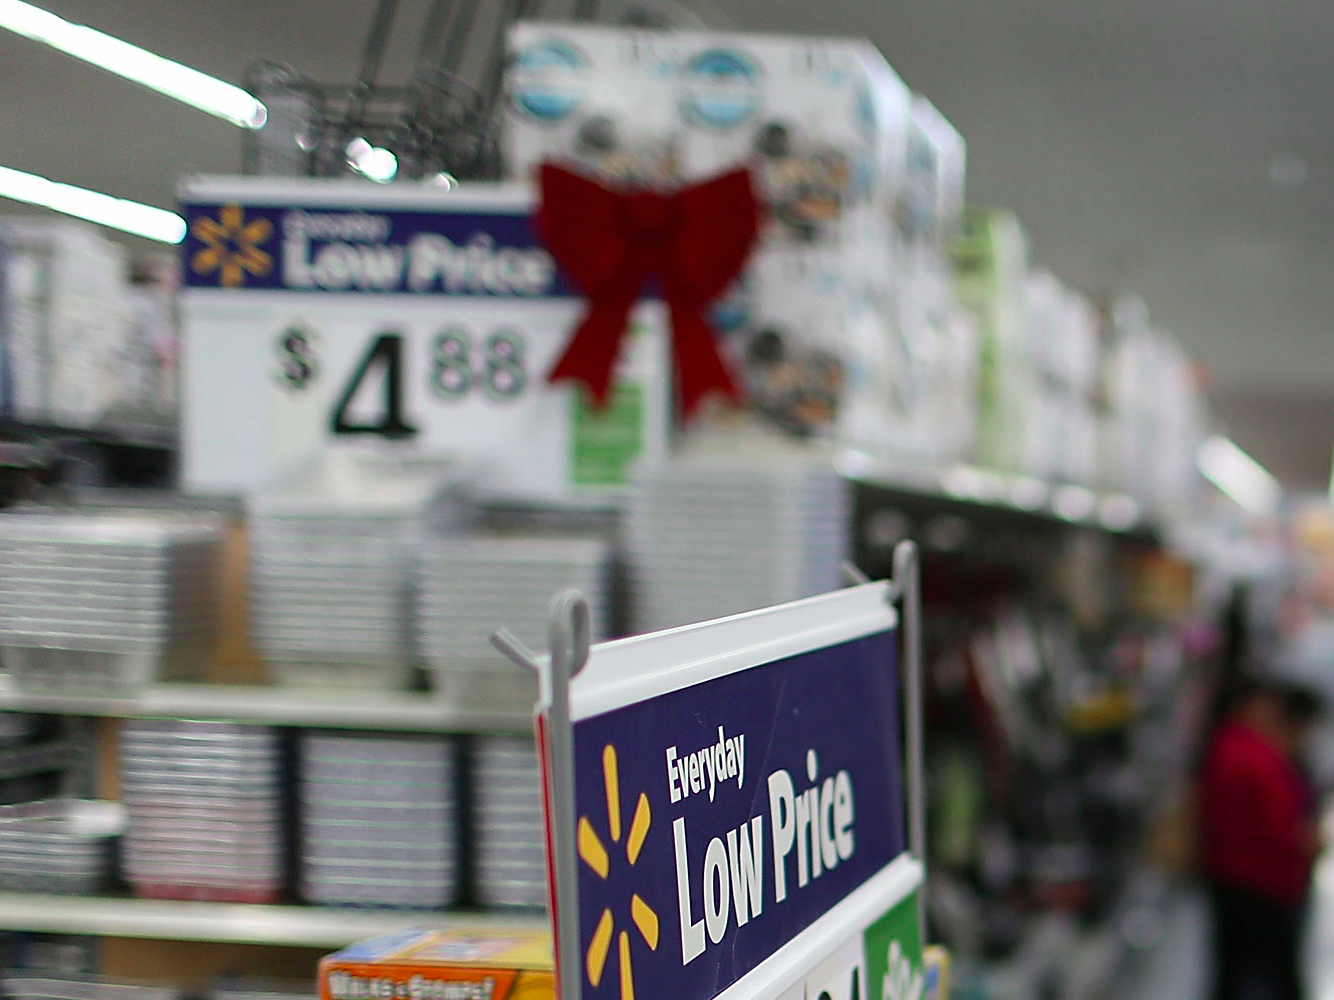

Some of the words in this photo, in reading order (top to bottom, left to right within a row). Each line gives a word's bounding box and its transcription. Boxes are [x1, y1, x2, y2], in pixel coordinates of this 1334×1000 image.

[283, 238, 402, 290] Low
[407, 232, 555, 293] Price
[331, 334, 420, 440] 4
[430, 327, 525, 400] 88
[666, 725, 745, 803] Everyday
[672, 815, 763, 966] Low
[767, 749, 856, 903] Price
